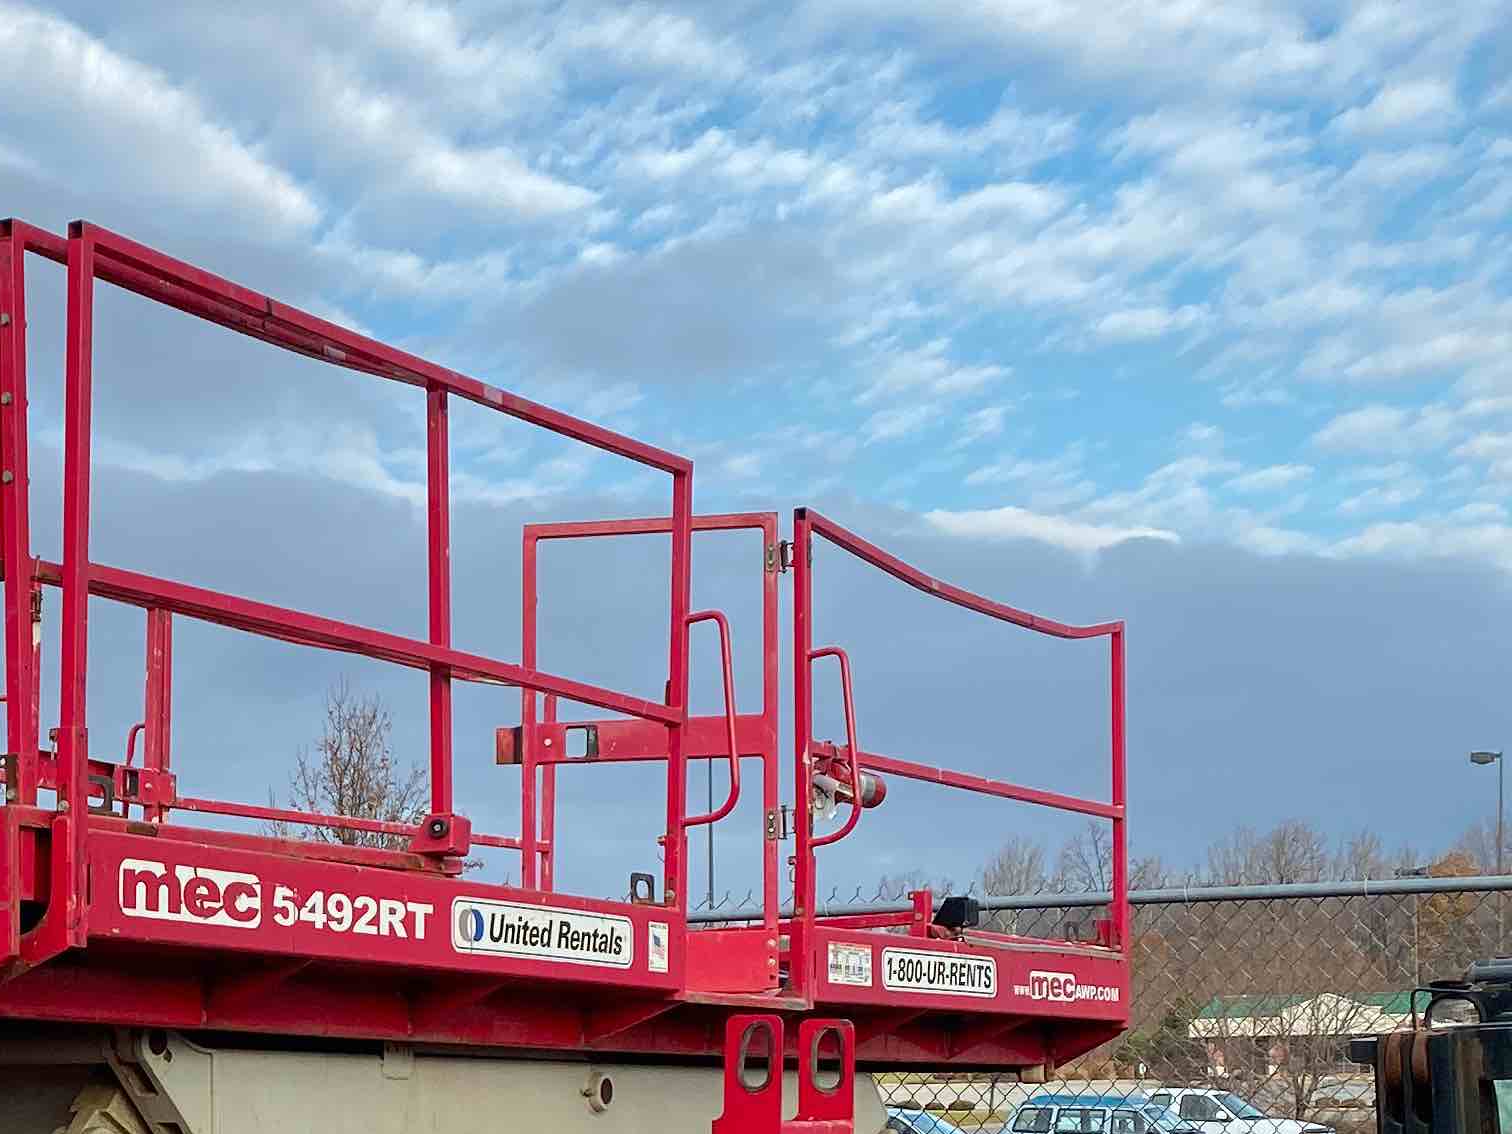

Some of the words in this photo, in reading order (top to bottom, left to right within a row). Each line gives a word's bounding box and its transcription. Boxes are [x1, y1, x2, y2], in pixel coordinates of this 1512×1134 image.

[122, 866, 260, 922] mec
[272, 886, 433, 940] 5492RT
[488, 914, 553, 949] United
[556, 926, 623, 957] Rentals
[887, 957, 992, 989] 1-800-UR-RENTS
